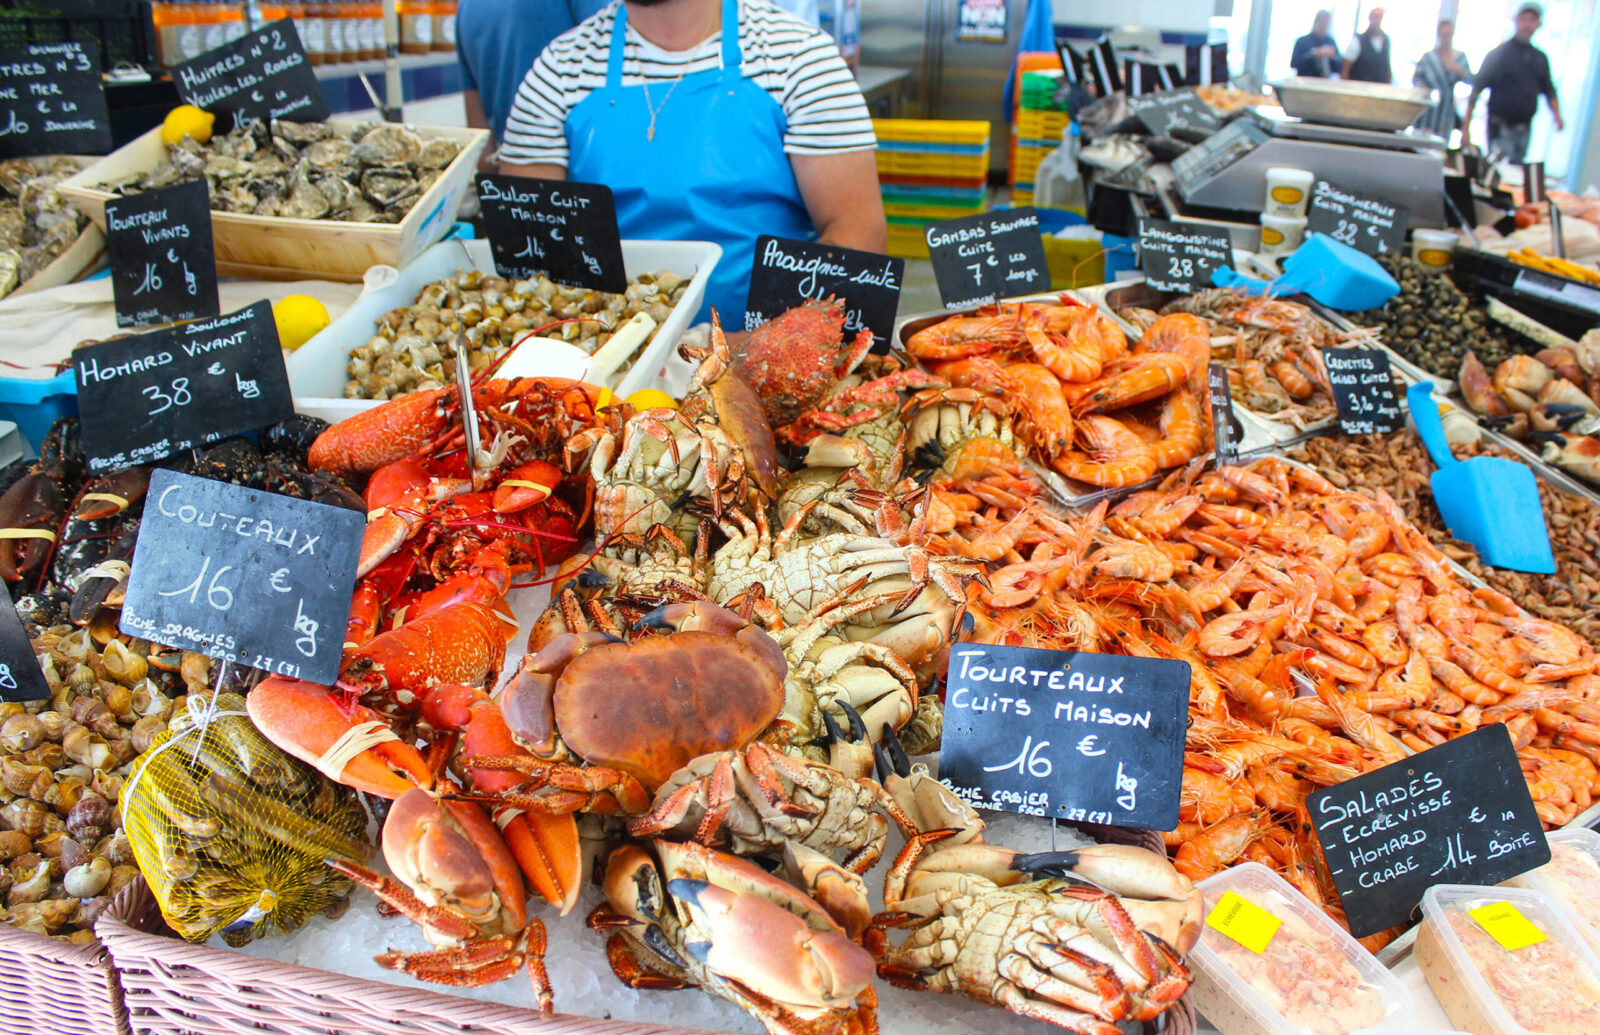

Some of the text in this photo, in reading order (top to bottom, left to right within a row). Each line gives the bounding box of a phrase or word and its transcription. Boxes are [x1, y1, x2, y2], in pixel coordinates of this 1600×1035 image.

[0, 61, 46, 77] TRES
[0, 82, 63, 100] NE MER
[480, 180, 539, 204] BULOT
[514, 235, 546, 259] 14
[550, 228, 564, 241] €
[926, 227, 986, 248] GAMBAS
[1330, 219, 1358, 246] 22
[132, 248, 197, 296] 16 € kg
[582, 251, 602, 275] kg
[849, 260, 900, 290] cuite
[966, 263, 983, 287] 7
[986, 255, 999, 267] €
[1168, 256, 1194, 278] 28
[185, 308, 255, 335] BOULOGNE
[79, 331, 248, 387] HOMARD VIVANT
[142, 361, 261, 416] 38 € kg
[158, 484, 321, 556] COUTEAUX
[158, 556, 320, 657] 16 € kg
[957, 650, 1125, 695] TOURTEAUX
[951, 688, 1152, 729] CUITS MAISON
[983, 734, 1138, 811] 16 € kg
[991, 790, 1049, 808] CASIER
[1319, 771, 1443, 831] SALADES
[1468, 806, 1488, 824] €
[1342, 790, 1452, 844] ECREVISSE
[1349, 829, 1427, 868] HOMARD
[1430, 832, 1477, 877] 14
[1358, 856, 1420, 889] CRABE
